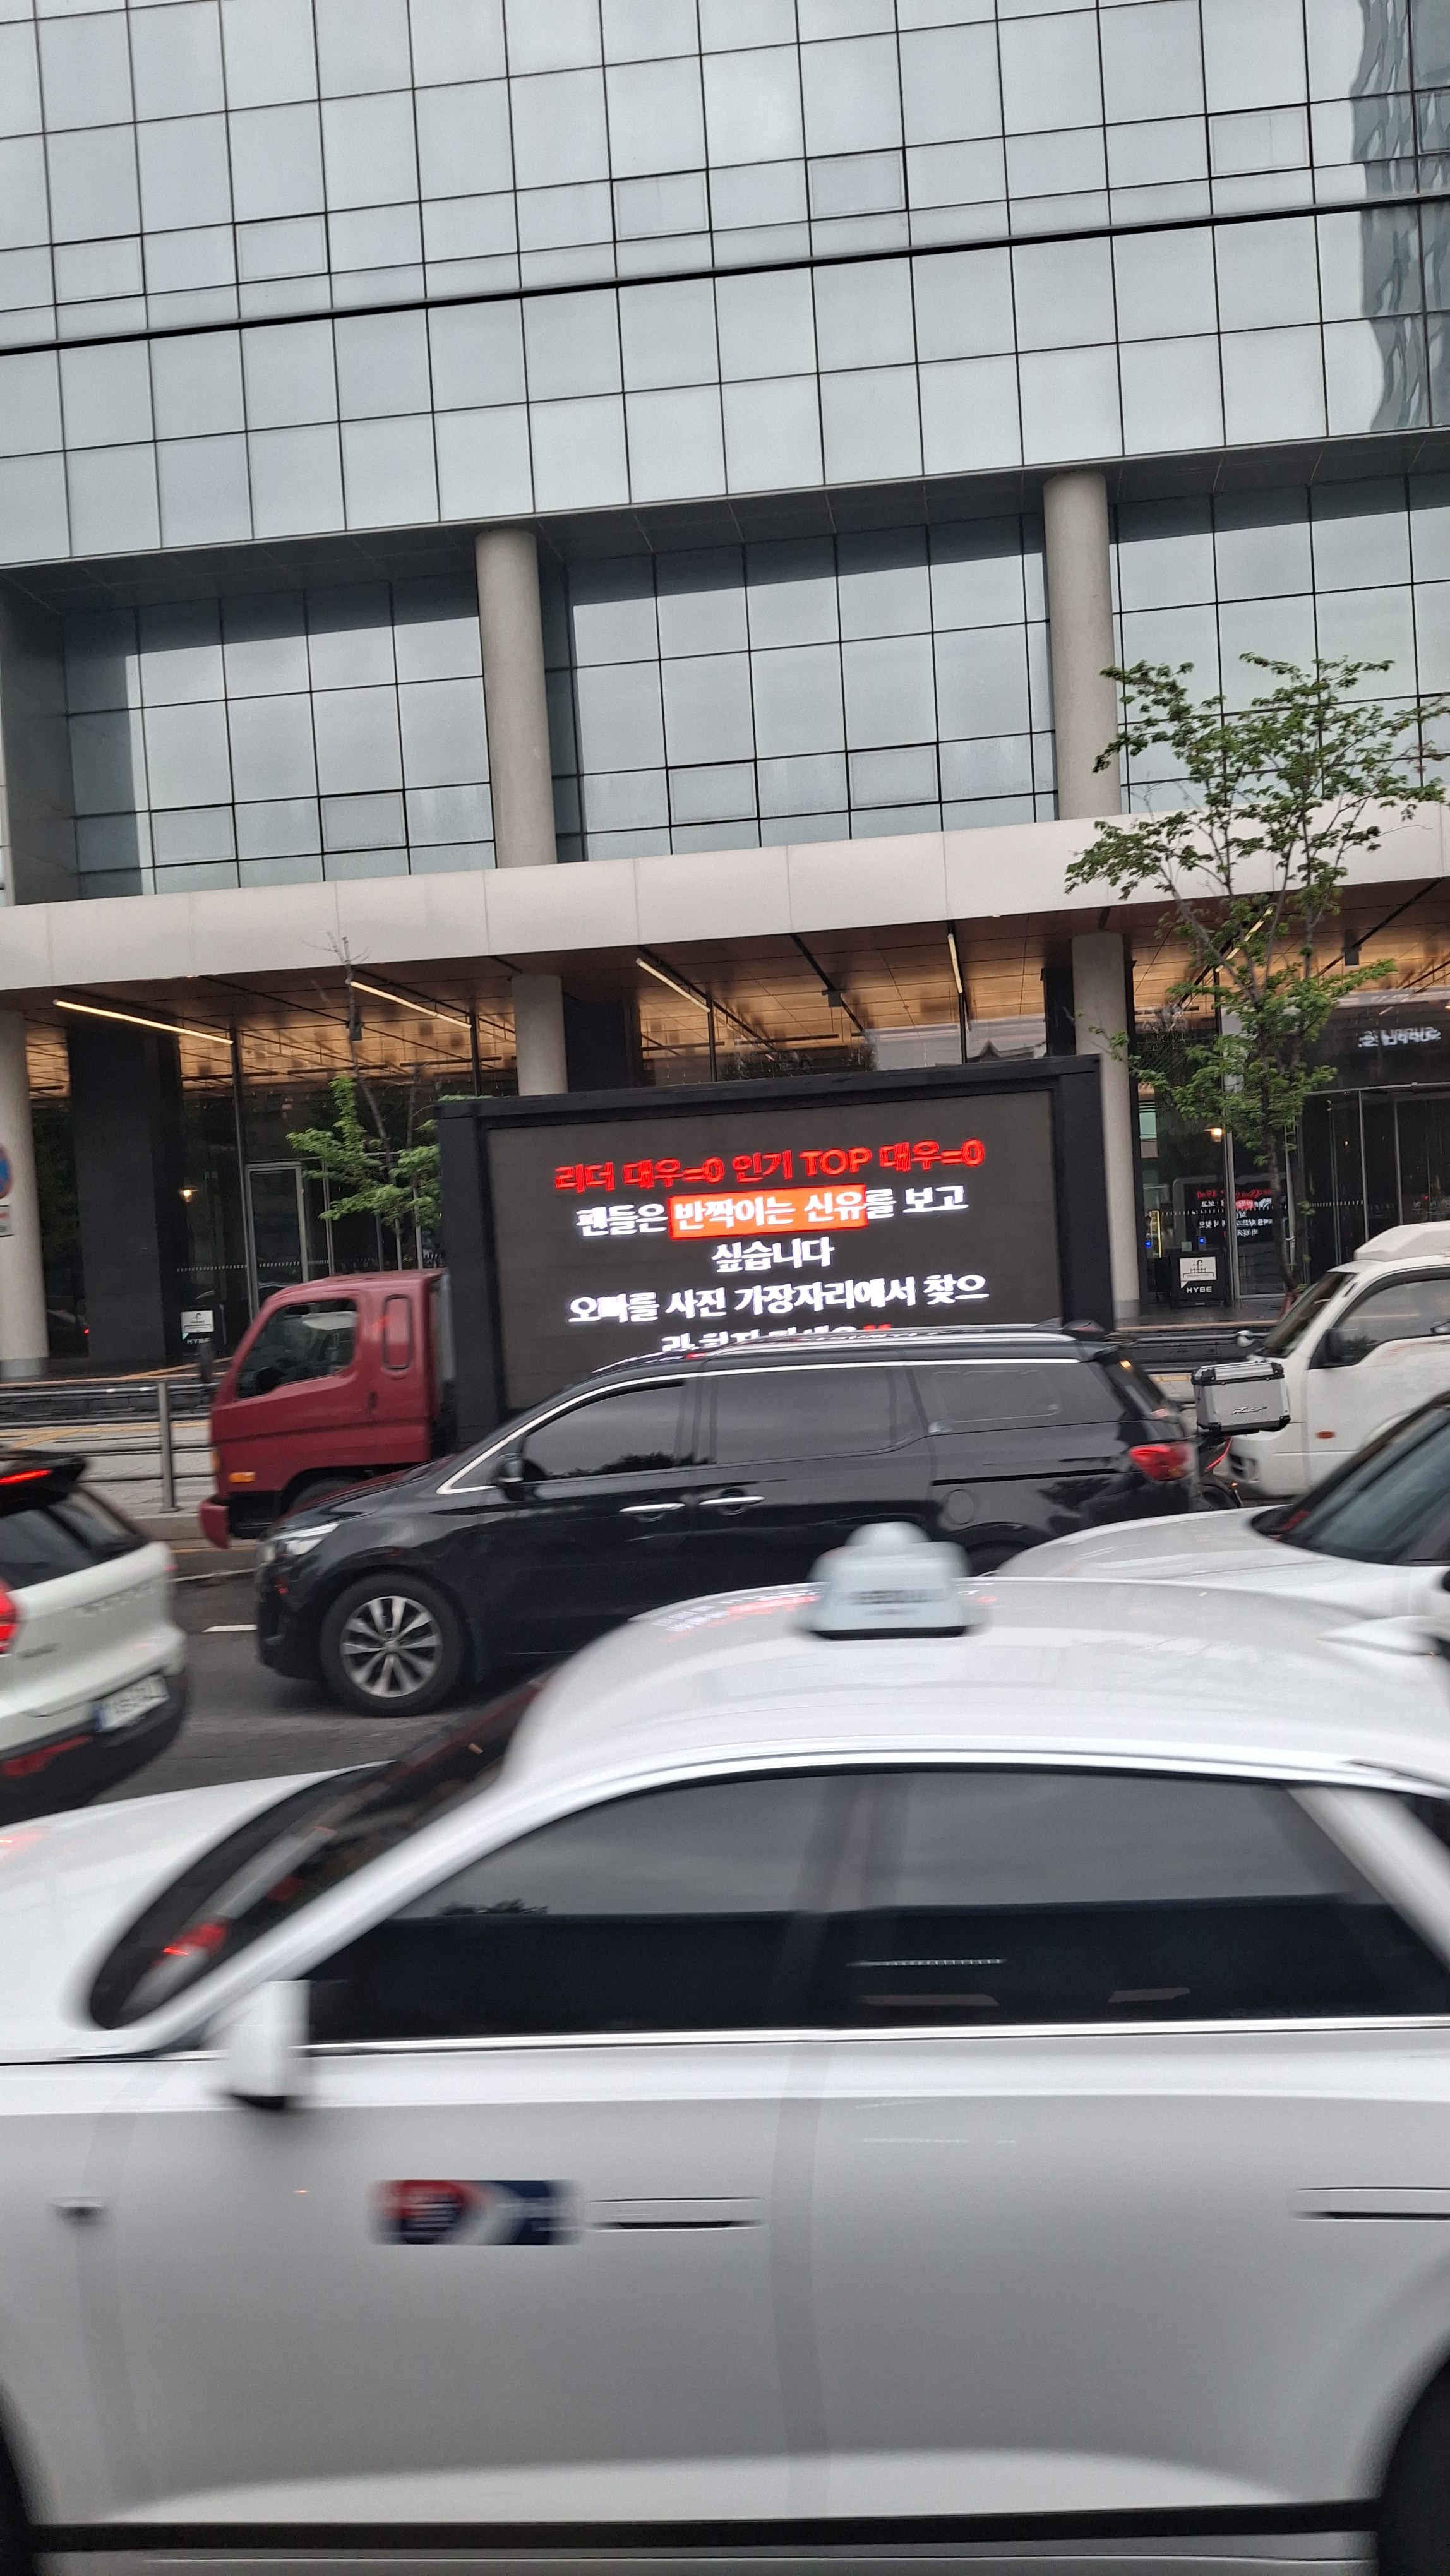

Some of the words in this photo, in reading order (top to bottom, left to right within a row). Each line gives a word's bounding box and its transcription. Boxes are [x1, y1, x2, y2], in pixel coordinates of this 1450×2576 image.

[556, 1163, 615, 1193] 리더
[623, 1157, 726, 1189] 대우=0
[731, 1150, 793, 1183] 인기
[798, 1146, 872, 1176] TOP
[878, 1138, 985, 1172] 대우=0
[575, 1203, 668, 1237] 팬들은
[674, 1196, 796, 1231] 반짝이는
[804, 1188, 897, 1222] 신유를
[902, 1185, 969, 1213] 보고
[711, 1236, 835, 1273] 싶습니다
[568, 1292, 660, 1323] 오빠를
[664, 1287, 728, 1320] 사진
[734, 1276, 916, 1315] 가장자리에서
[923, 1274, 990, 1306] 찾으
[1186, 1285, 1213, 1294] HYBE
